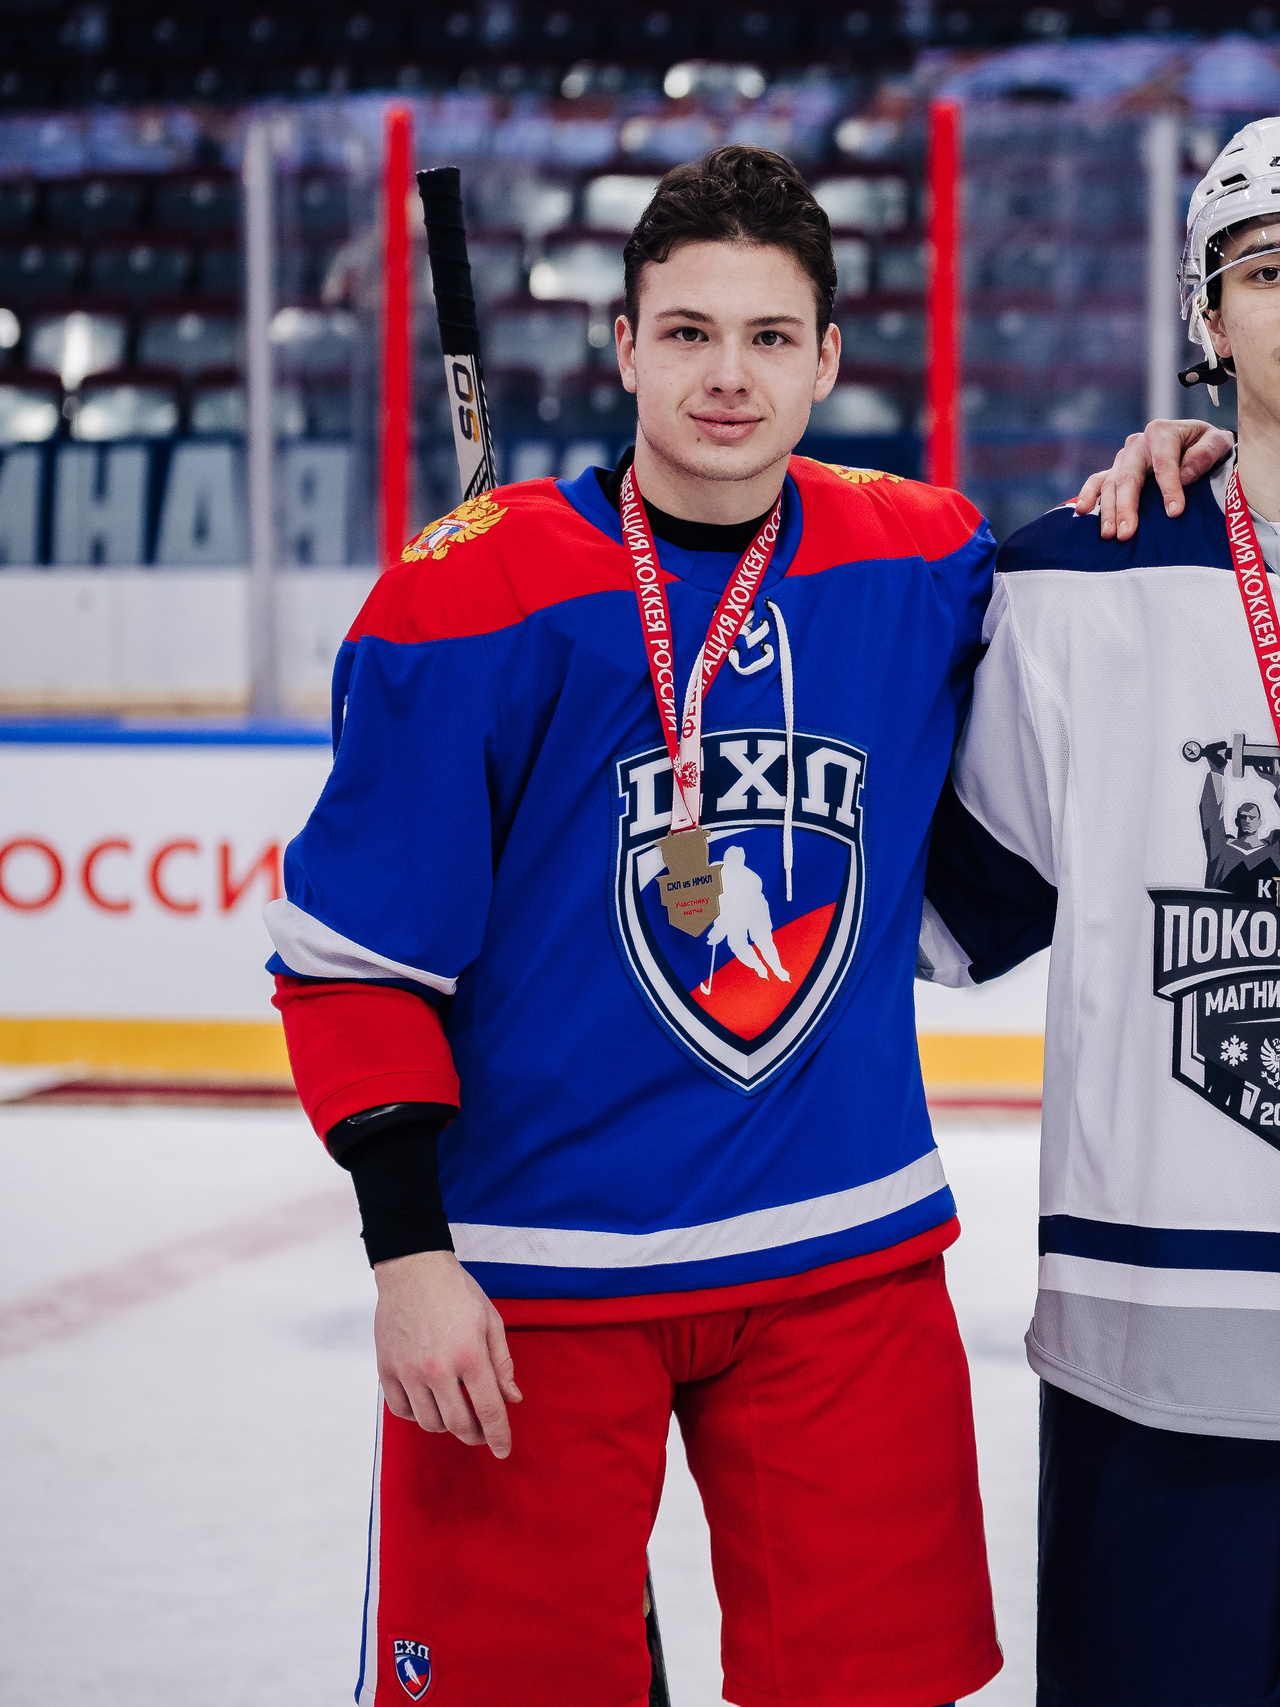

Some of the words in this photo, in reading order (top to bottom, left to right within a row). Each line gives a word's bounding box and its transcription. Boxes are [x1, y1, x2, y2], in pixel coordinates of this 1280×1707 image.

[725, 546, 767, 616] ХОККЕЯ
[757, 500, 781, 552] РОСС
[1239, 563, 1279, 648] ХОККЕЯ
[632, 552, 668, 633] ХОККЕЯ
[650, 638, 678, 732] РОССИИ
[682, 880, 692, 889] vs
[692, 874, 713, 887] НМХЛ
